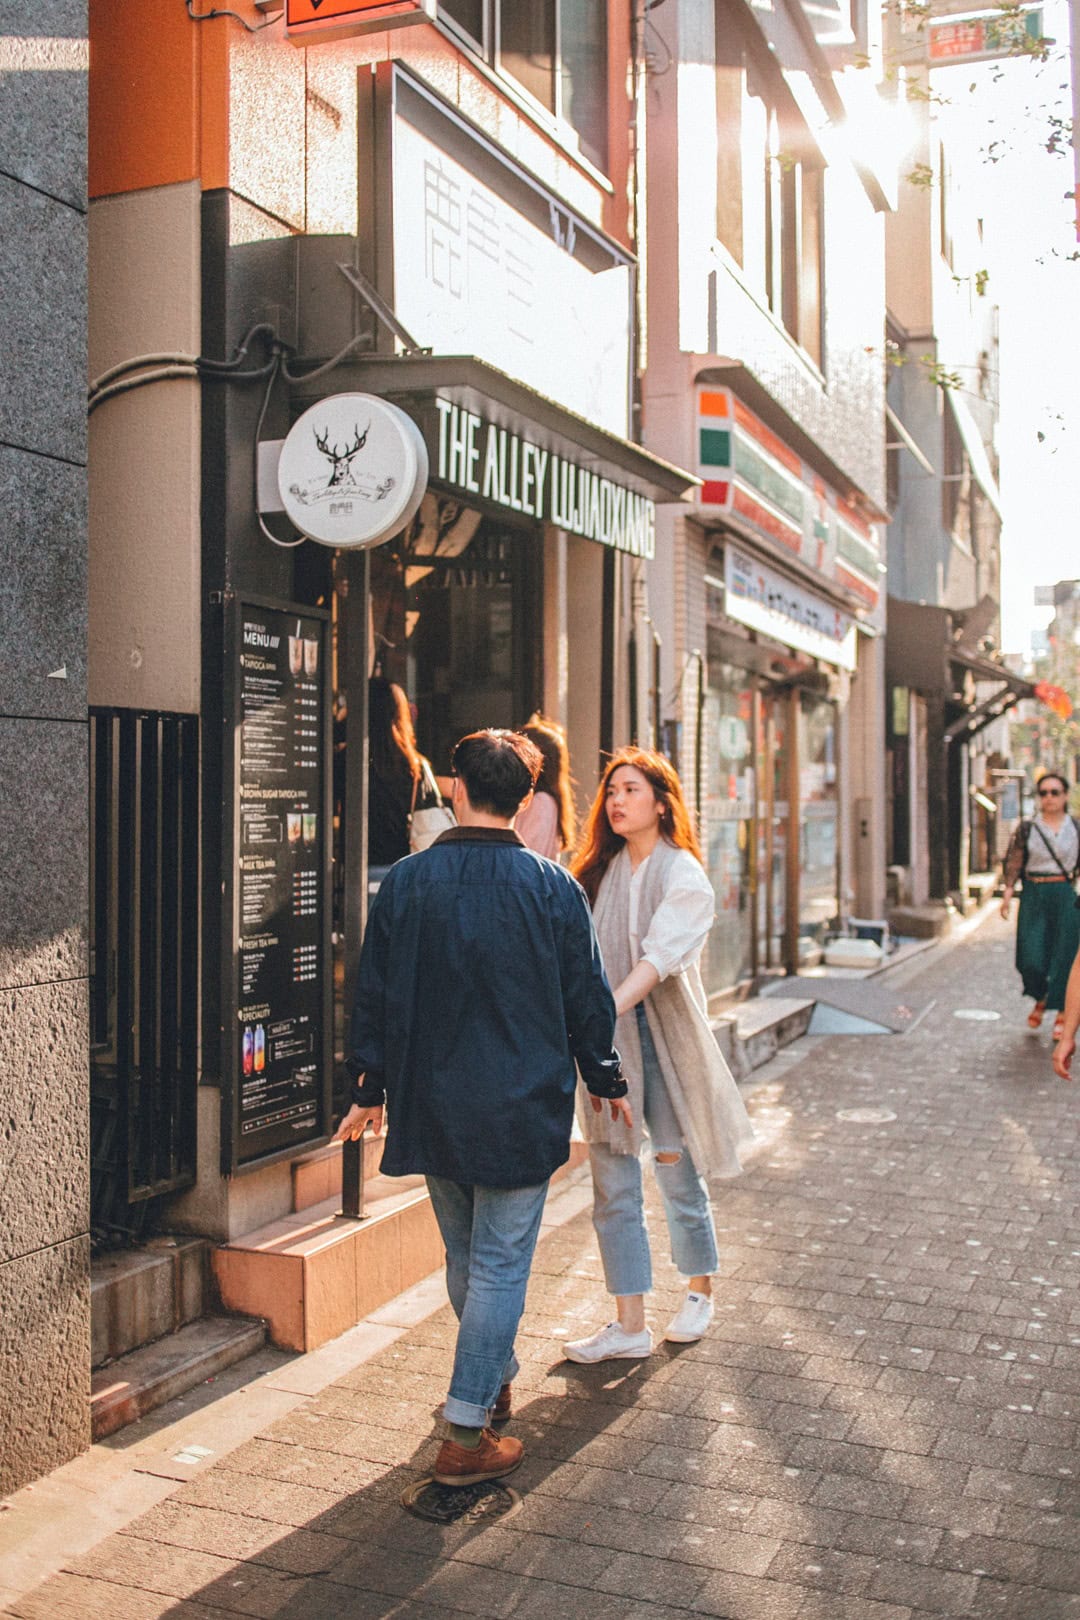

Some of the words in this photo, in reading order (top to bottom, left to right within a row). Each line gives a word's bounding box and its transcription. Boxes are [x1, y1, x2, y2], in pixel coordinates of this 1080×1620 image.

[435, 397, 481, 493] THE
[483, 424, 548, 519] ALLEY
[550, 455, 656, 560] LUJIAOXIANG
[243, 631, 270, 648] MENU
